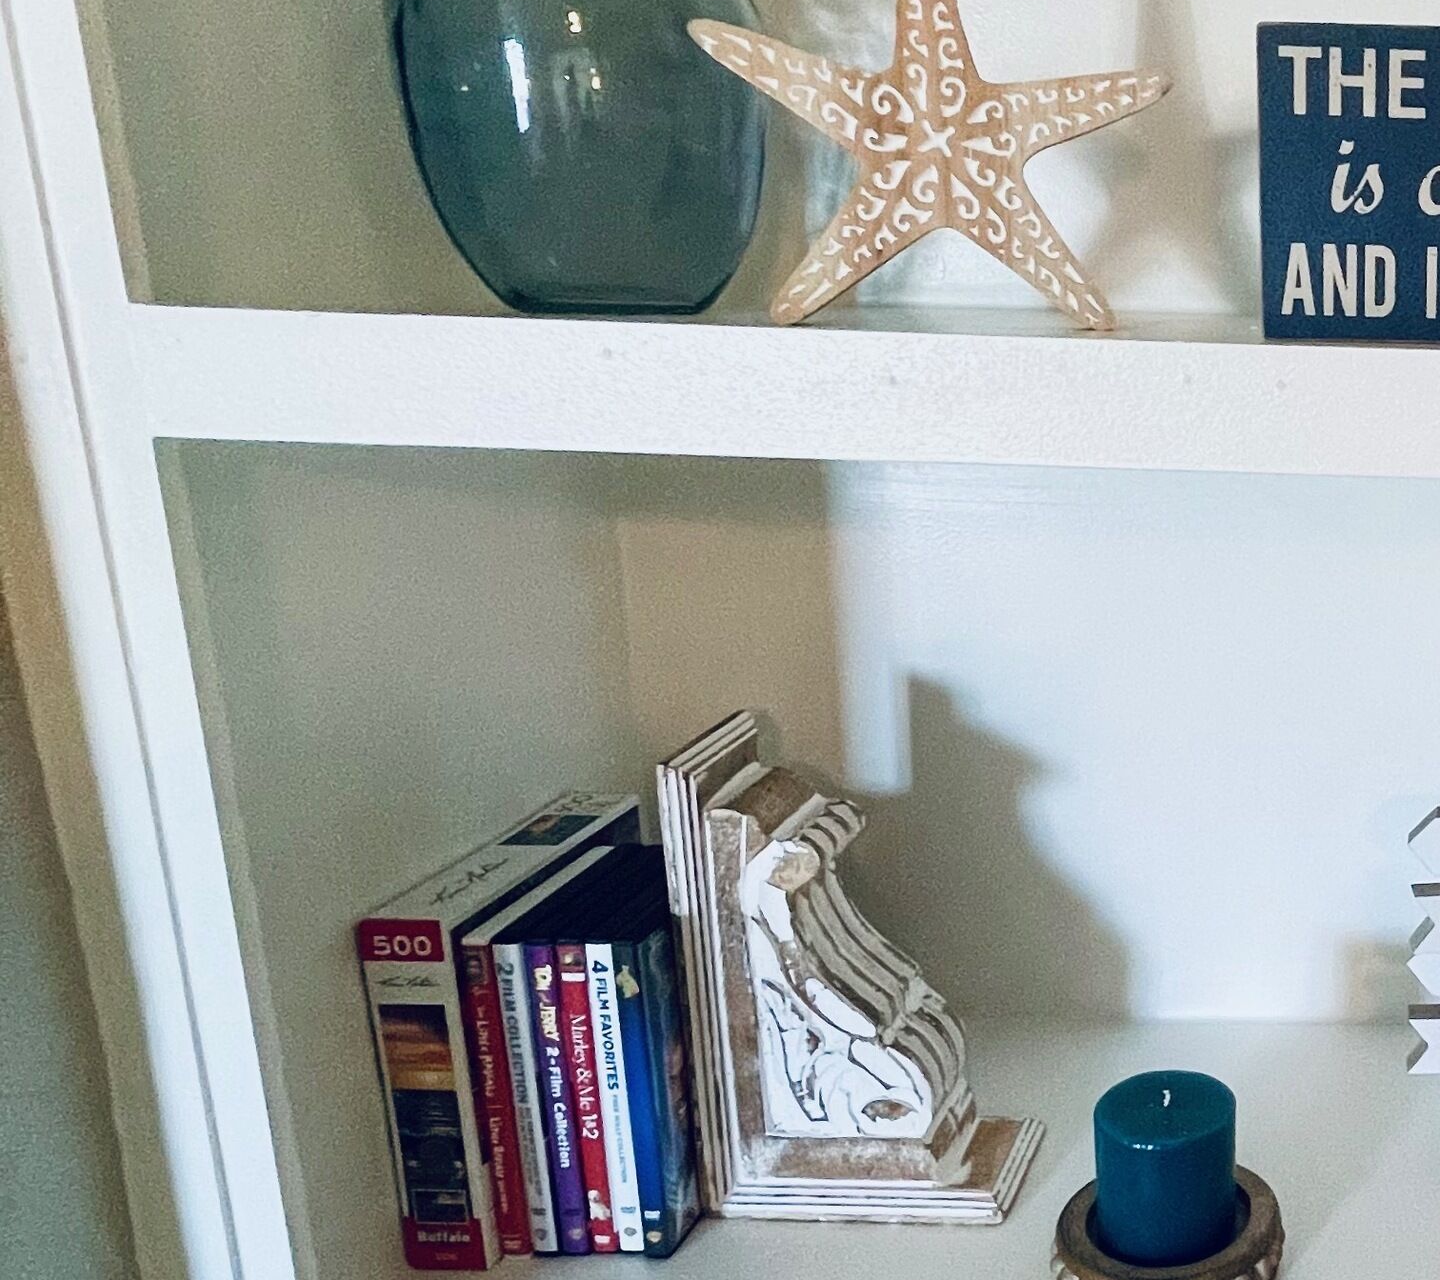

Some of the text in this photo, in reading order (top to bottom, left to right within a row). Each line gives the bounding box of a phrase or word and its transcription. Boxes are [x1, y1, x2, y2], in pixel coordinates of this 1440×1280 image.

[1278, 44, 1427, 120] THE
[1331, 139, 1385, 215] is
[1281, 242, 1396, 318] AND
[1425, 246, 1438, 319] I
[372, 934, 432, 957] 500
[591, 960, 609, 974] 4
[595, 978, 610, 1010] FILM
[507, 1015, 530, 1105] COLLECTION
[570, 1014, 591, 1066] Marley
[599, 1014, 620, 1091] FAVORITES
